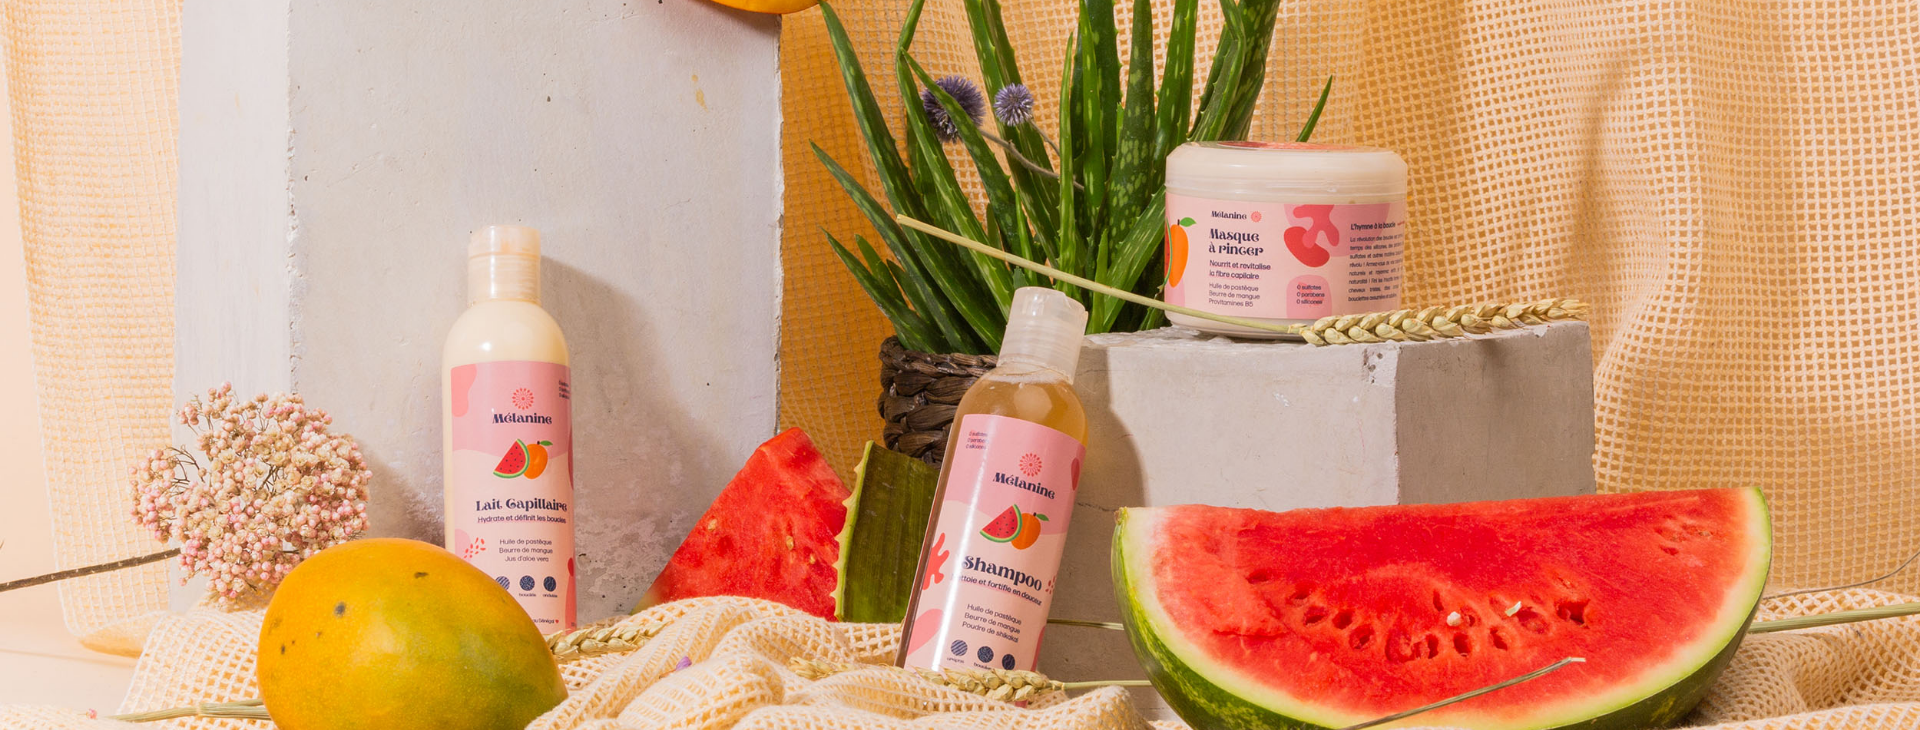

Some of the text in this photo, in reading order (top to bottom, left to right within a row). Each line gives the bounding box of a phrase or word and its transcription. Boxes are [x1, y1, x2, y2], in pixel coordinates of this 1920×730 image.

[1211, 210, 1247, 220] Mélanine
[1351, 222, 1373, 231] L'hymne
[1209, 228, 1260, 244] Masque
[1208, 241, 1264, 257] à rincer
[1209, 260, 1231, 268] Nourrit
[1209, 269, 1215, 277] la
[1209, 298, 1244, 306] Provitamines
[492, 412, 552, 425] Mélanine
[993, 472, 1056, 500] Mélanine
[475, 496, 568, 512] Lait Capillaire
[477, 514, 505, 524] Hydrate
[514, 513, 536, 521] définit
[525, 538, 553, 546] pastèque
[962, 556, 1042, 591] Shampoo
[978, 578, 987, 586] et
[987, 579, 1012, 593] fortifie
[1012, 588, 1022, 597] en
[1021, 591, 1042, 606] douceur
[966, 603, 1022, 626] Huile de pastèque
[961, 620, 986, 633] Poudre
[986, 627, 996, 635] de
[964, 612, 1021, 635] Beurre de mangue
